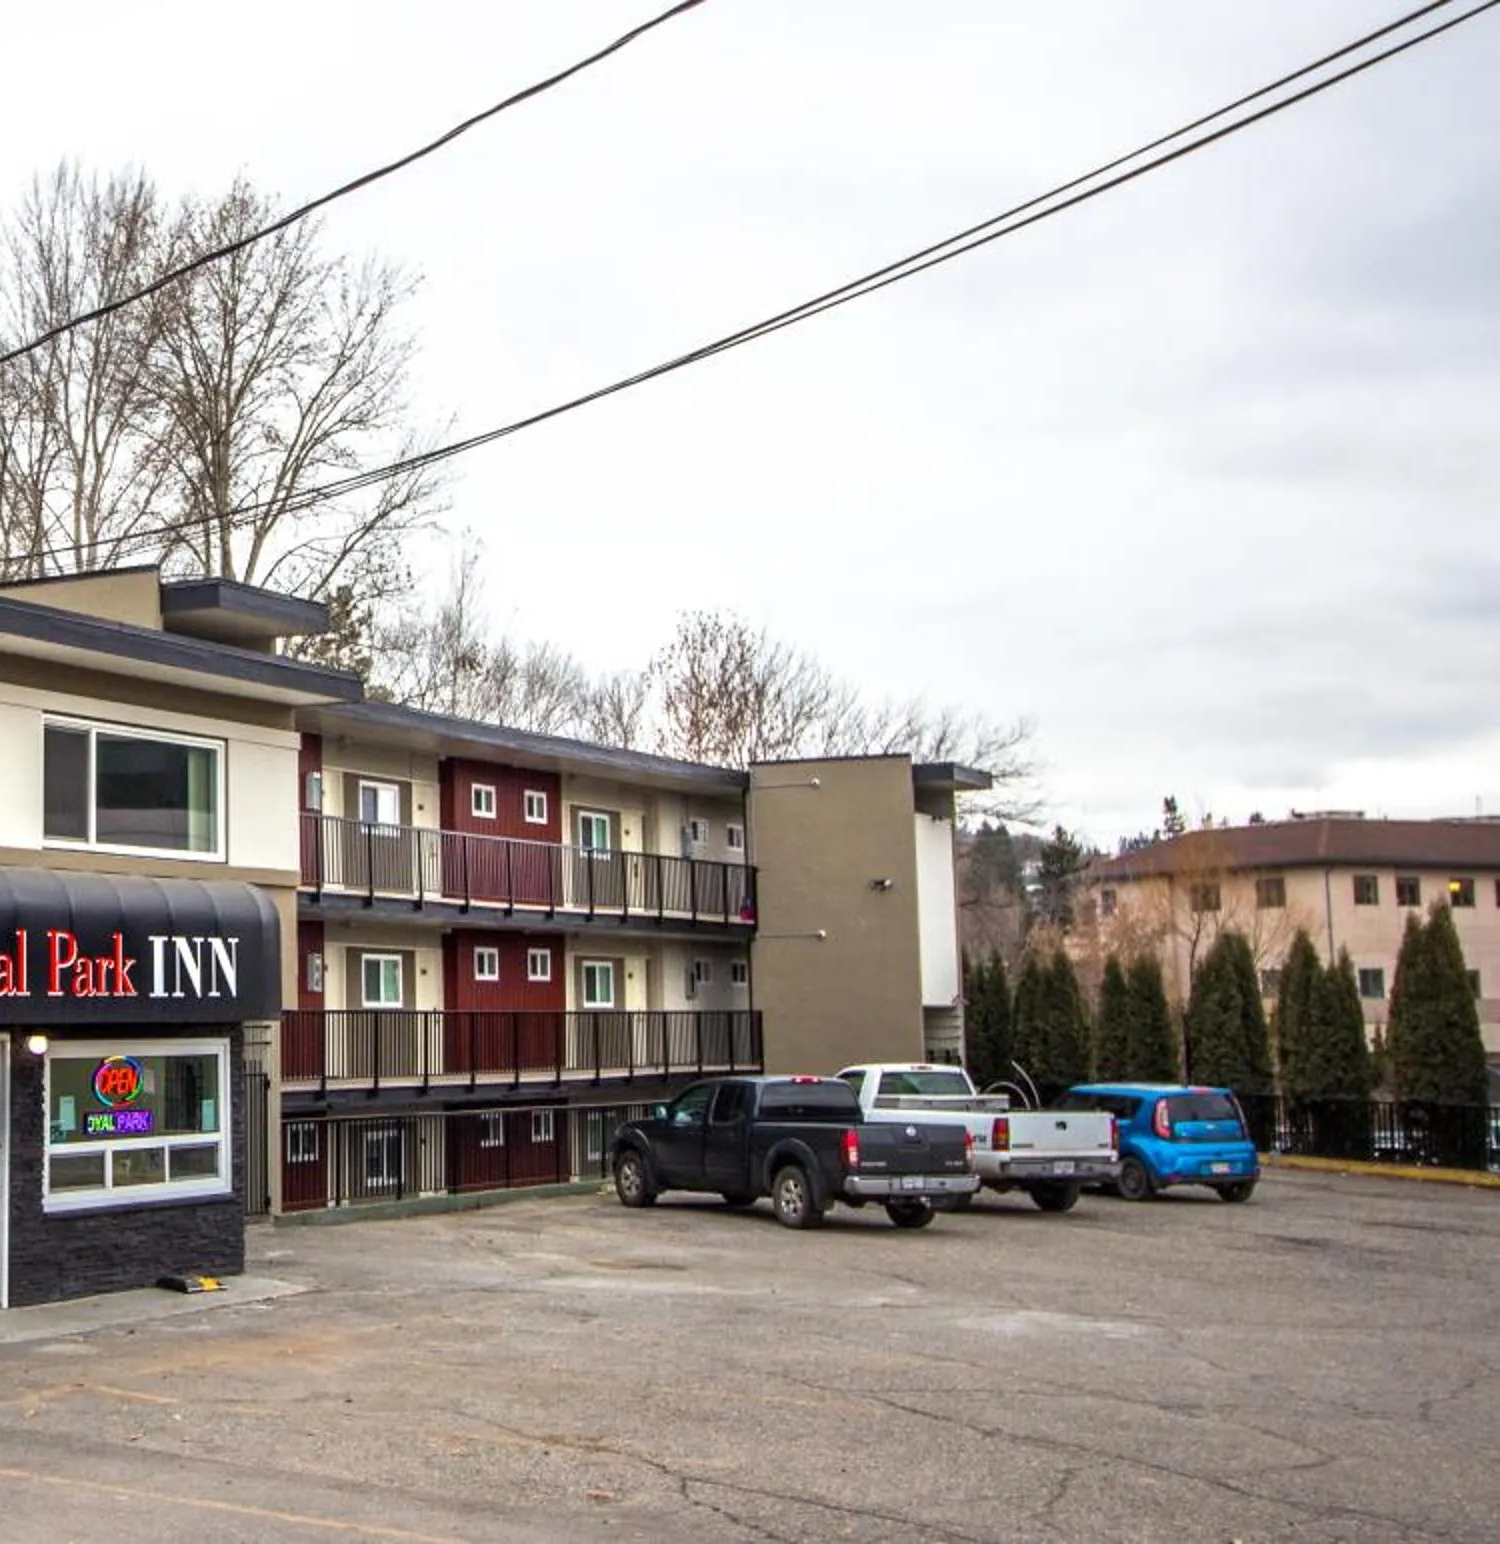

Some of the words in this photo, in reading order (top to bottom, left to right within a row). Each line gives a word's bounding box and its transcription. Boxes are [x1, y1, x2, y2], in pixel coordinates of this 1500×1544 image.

[46, 928, 139, 999] Park
[148, 935, 240, 999] INN
[99, 1066, 137, 1095] OPEN
[117, 1110, 150, 1133] PARK
